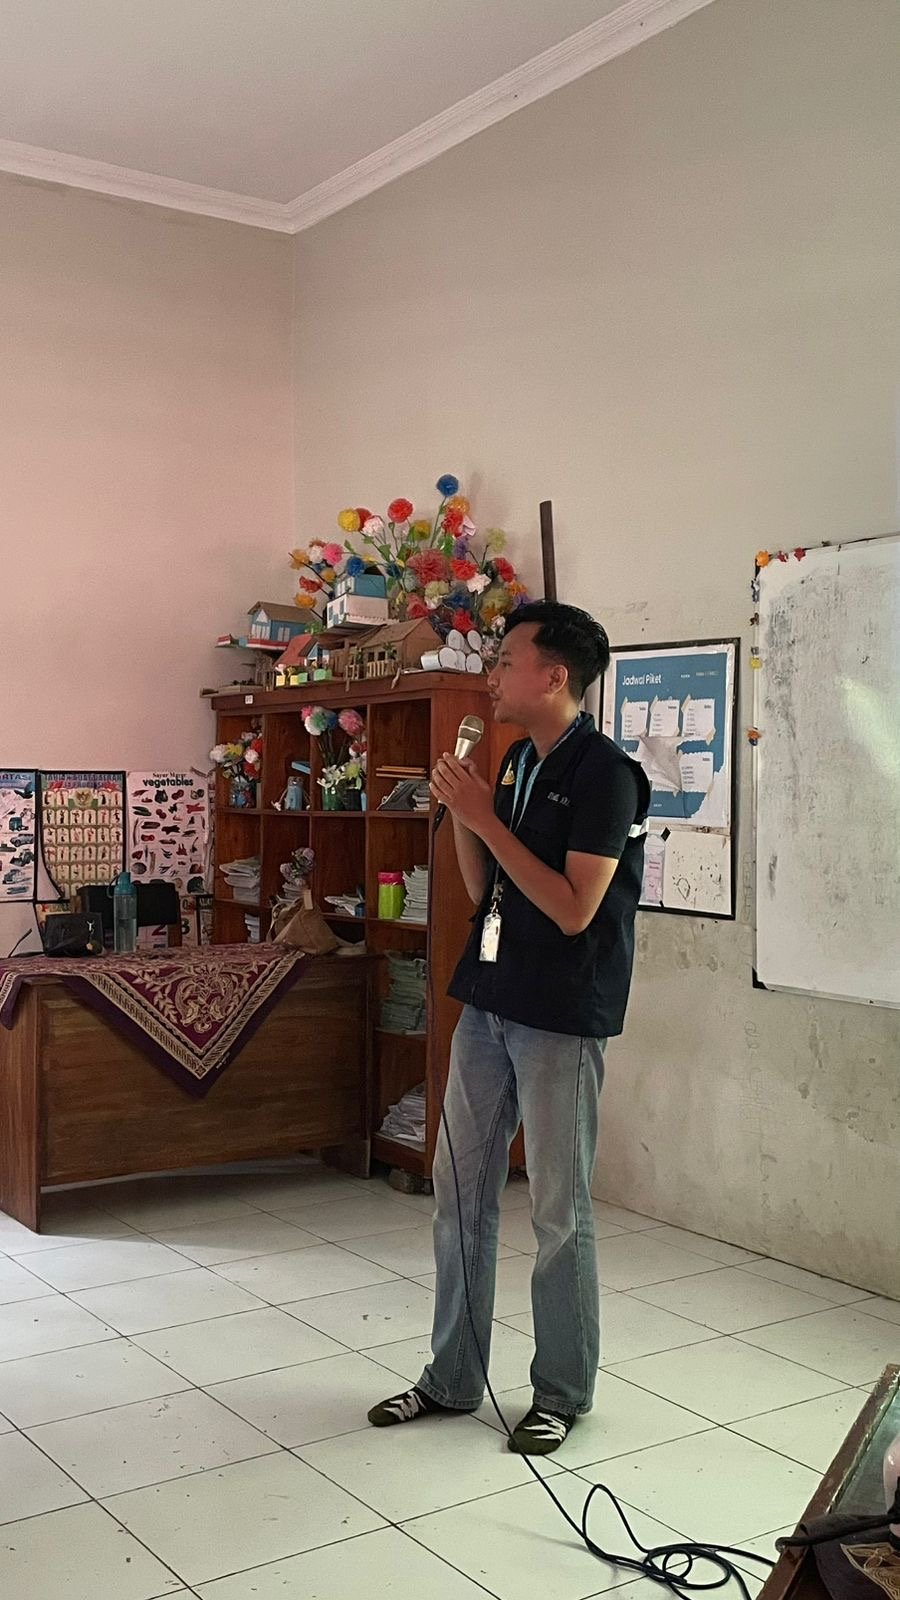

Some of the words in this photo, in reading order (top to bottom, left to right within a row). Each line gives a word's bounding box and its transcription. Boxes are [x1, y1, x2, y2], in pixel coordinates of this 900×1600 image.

[622, 674, 645, 686] Jadwal
[646, 672, 662, 685] Piket
[0, 773, 31, 781] RTASI
[142, 776, 194, 788] vegetables
